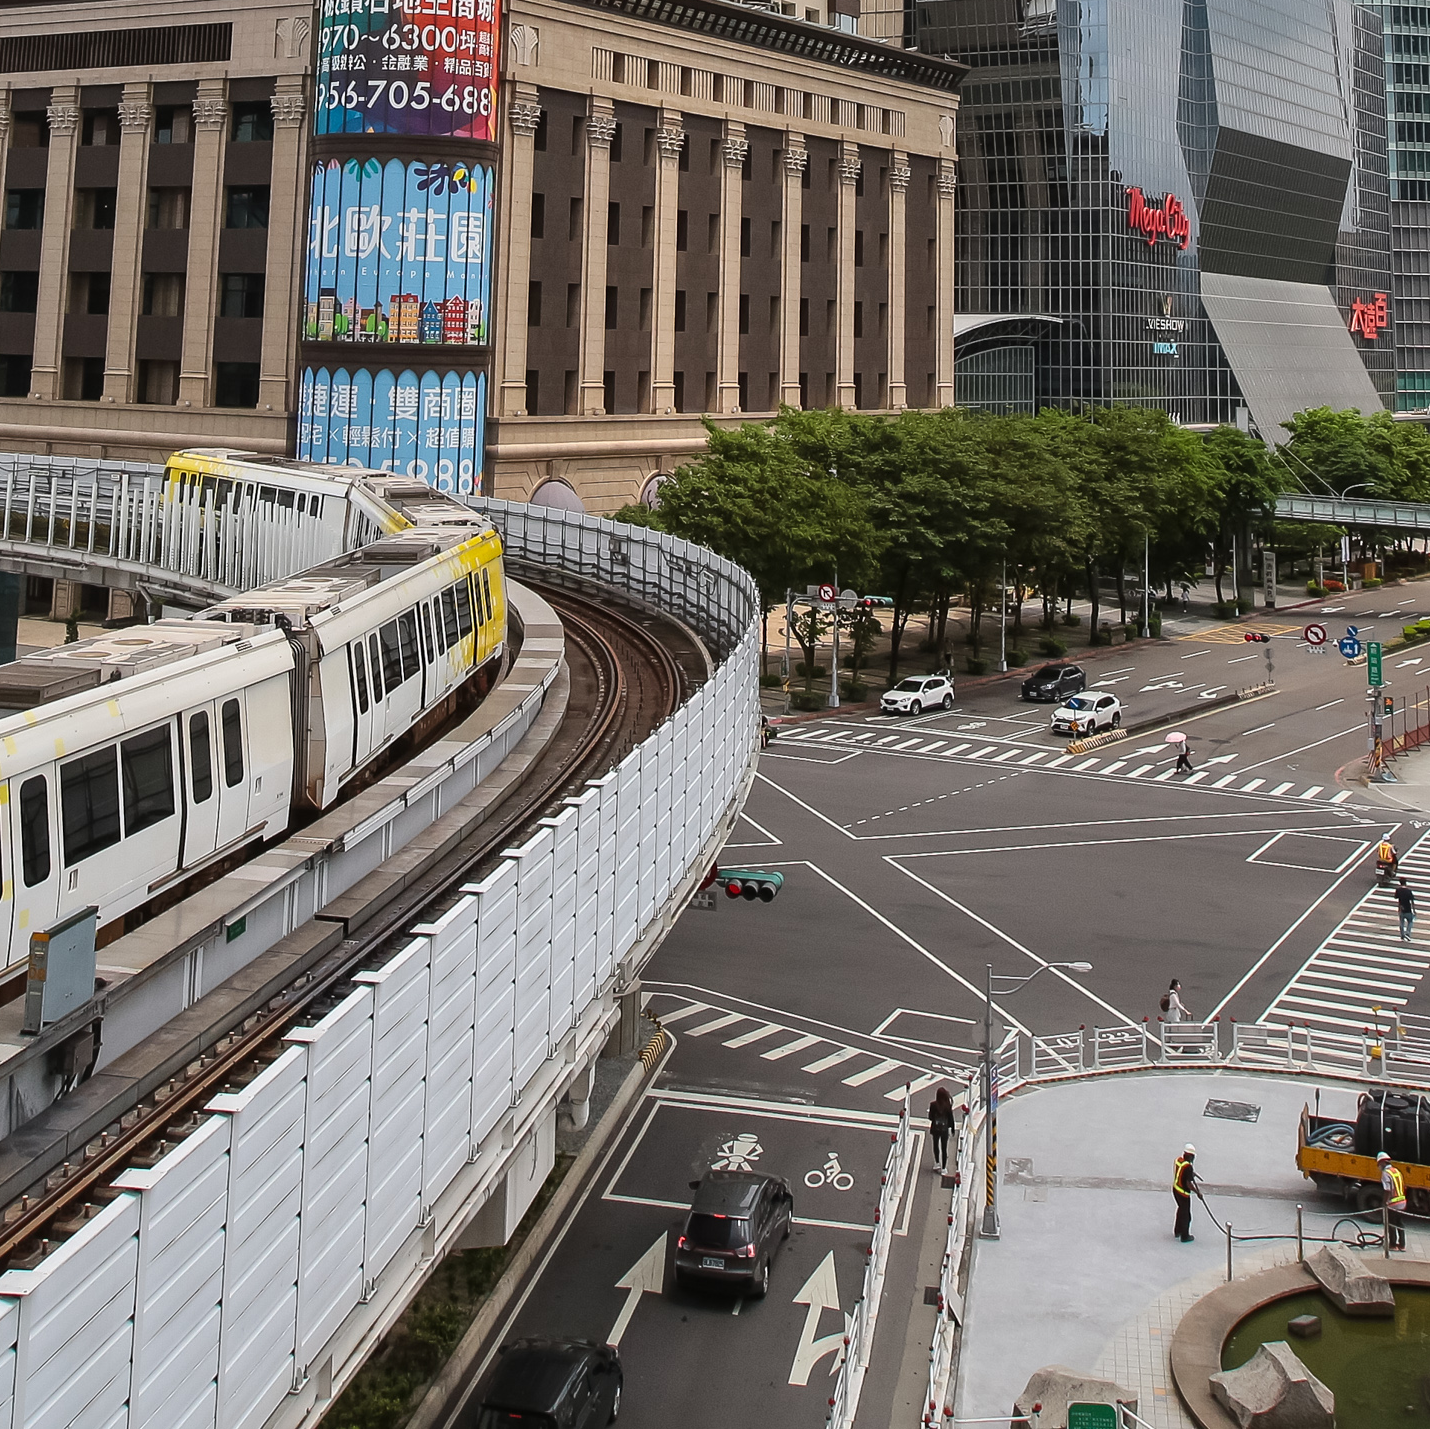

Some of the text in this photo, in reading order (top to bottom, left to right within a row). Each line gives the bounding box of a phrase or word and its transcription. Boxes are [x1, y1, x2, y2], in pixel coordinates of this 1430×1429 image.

[319, 24, 477, 55] 970~6300坪
[316, 80, 492, 116] 956-705-688
[309, 204, 486, 263] 北歐莊園
[361, 267, 430, 278] Europe
[387, 385, 477, 420] 雙商圈
